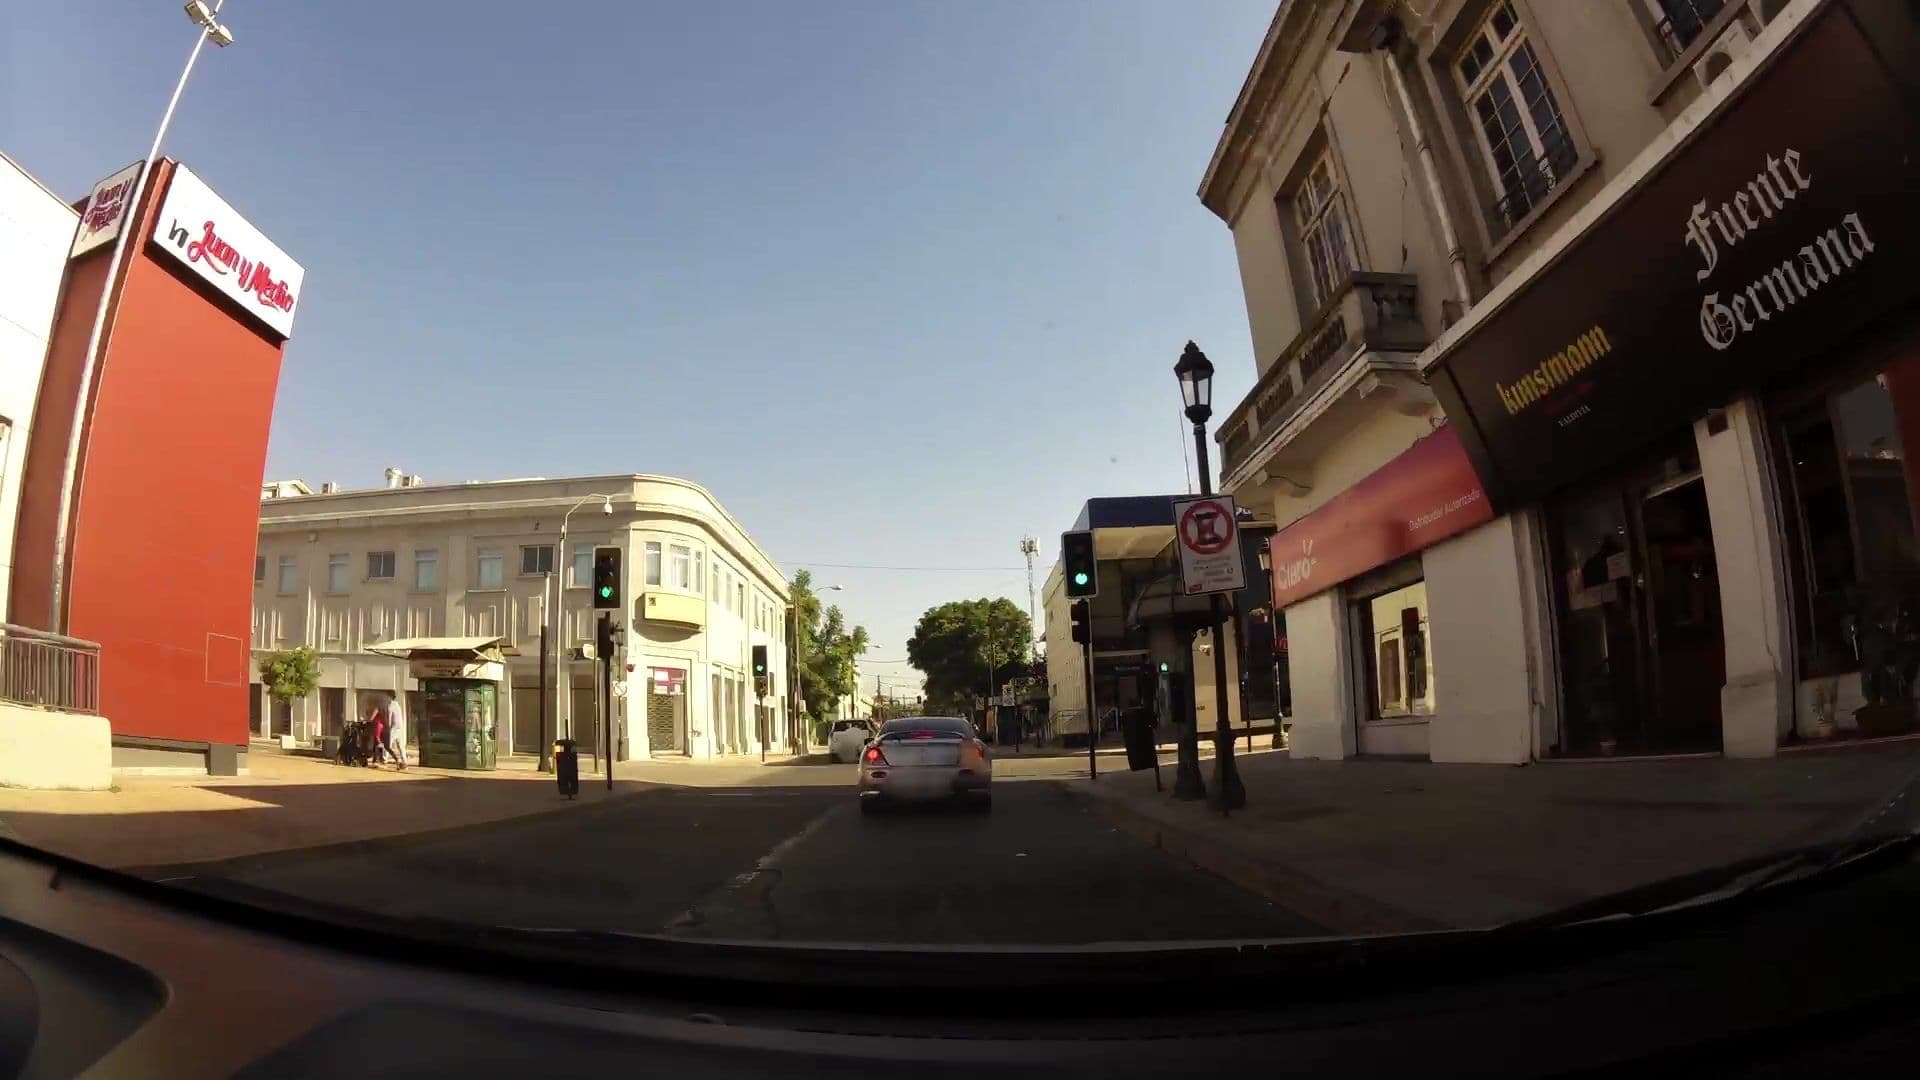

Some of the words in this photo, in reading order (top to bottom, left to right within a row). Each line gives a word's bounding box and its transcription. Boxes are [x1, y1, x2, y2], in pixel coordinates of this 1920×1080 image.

[187, 220, 240, 275] Juan
[1685, 147, 1812, 284] Fuente
[1700, 211, 1875, 350] Germana
[1278, 552, 1314, 590] Claro
